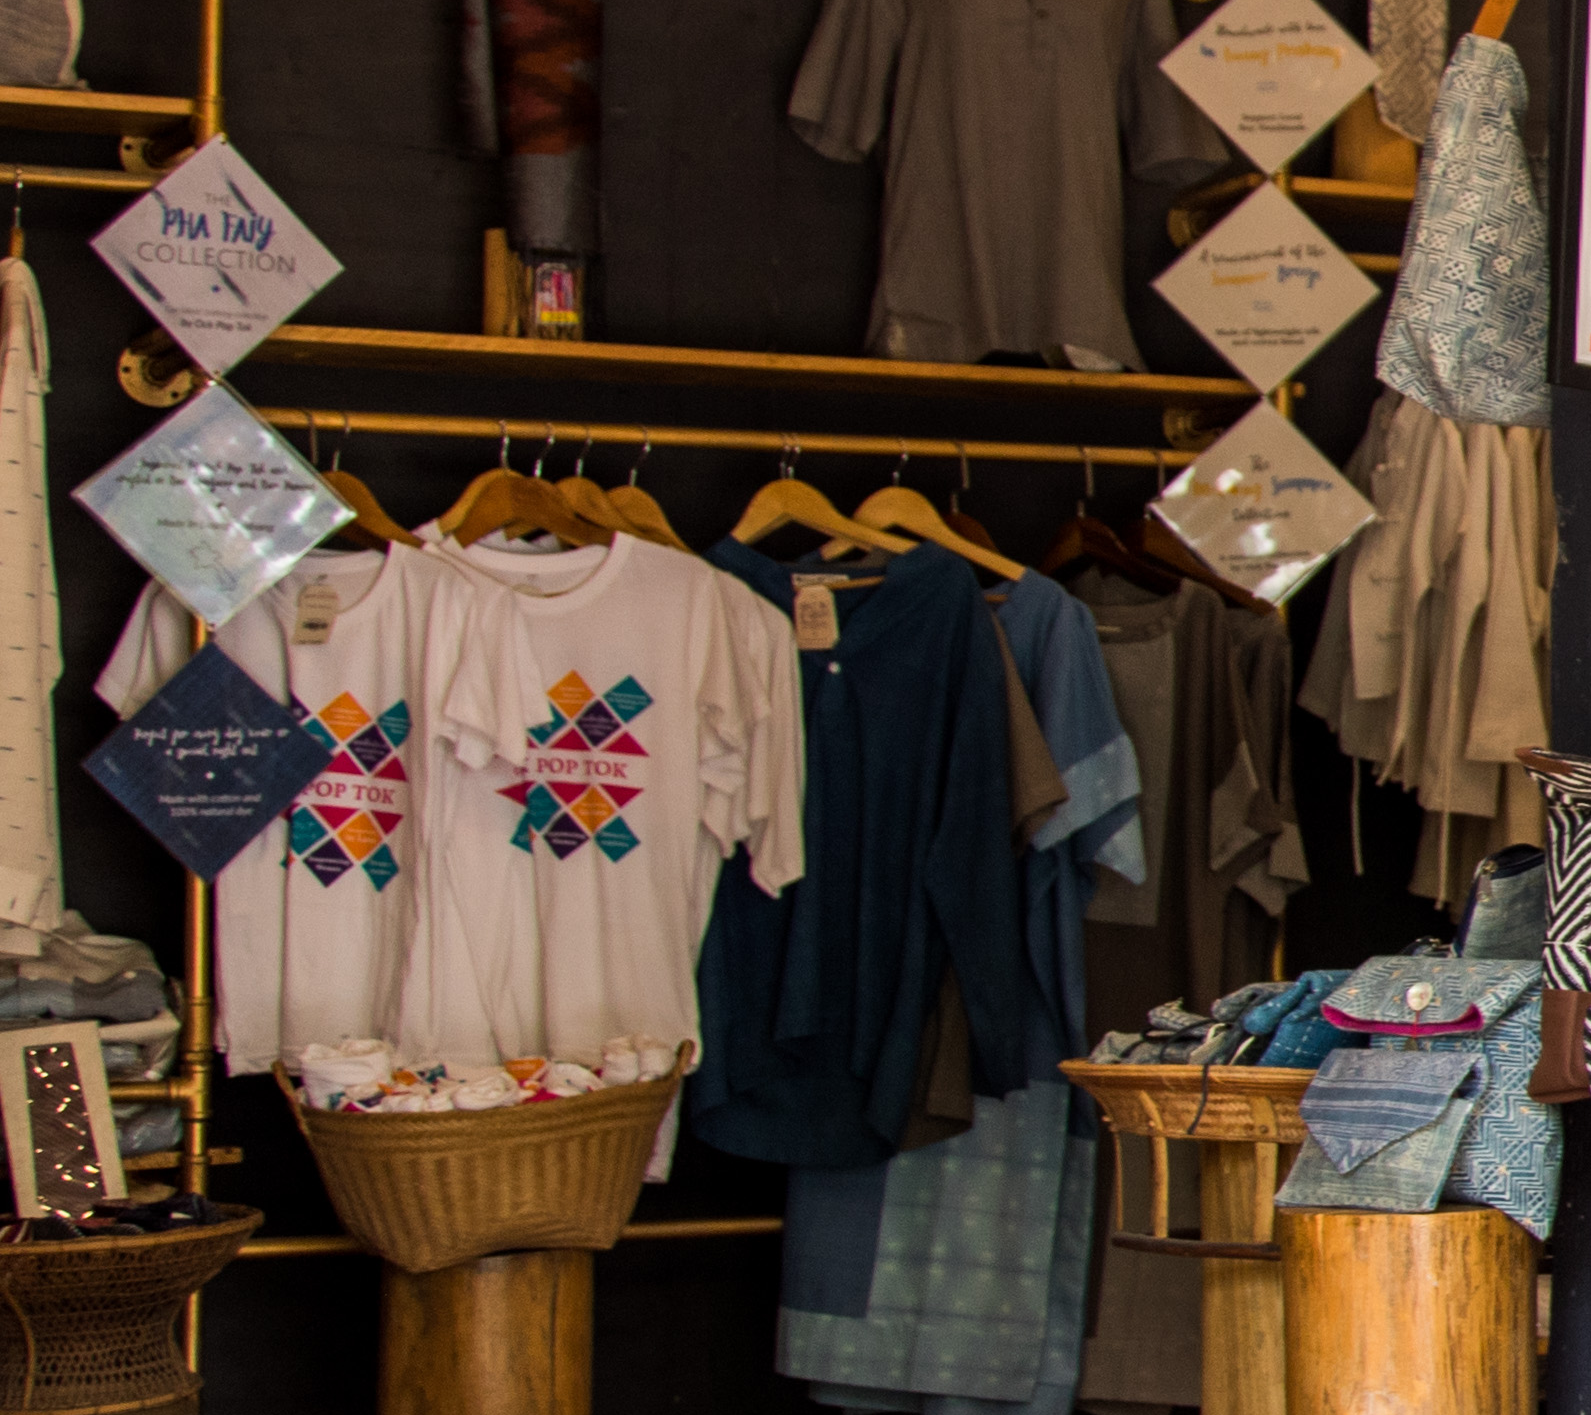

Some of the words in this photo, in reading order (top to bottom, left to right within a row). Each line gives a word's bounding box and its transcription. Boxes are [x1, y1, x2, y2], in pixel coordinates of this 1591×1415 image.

[162, 205, 210, 240] PHA
[137, 241, 296, 274] COLLECTION
[537, 757, 579, 775] POP
[585, 759, 629, 779] TOK
[352, 784, 395, 805] TOK
